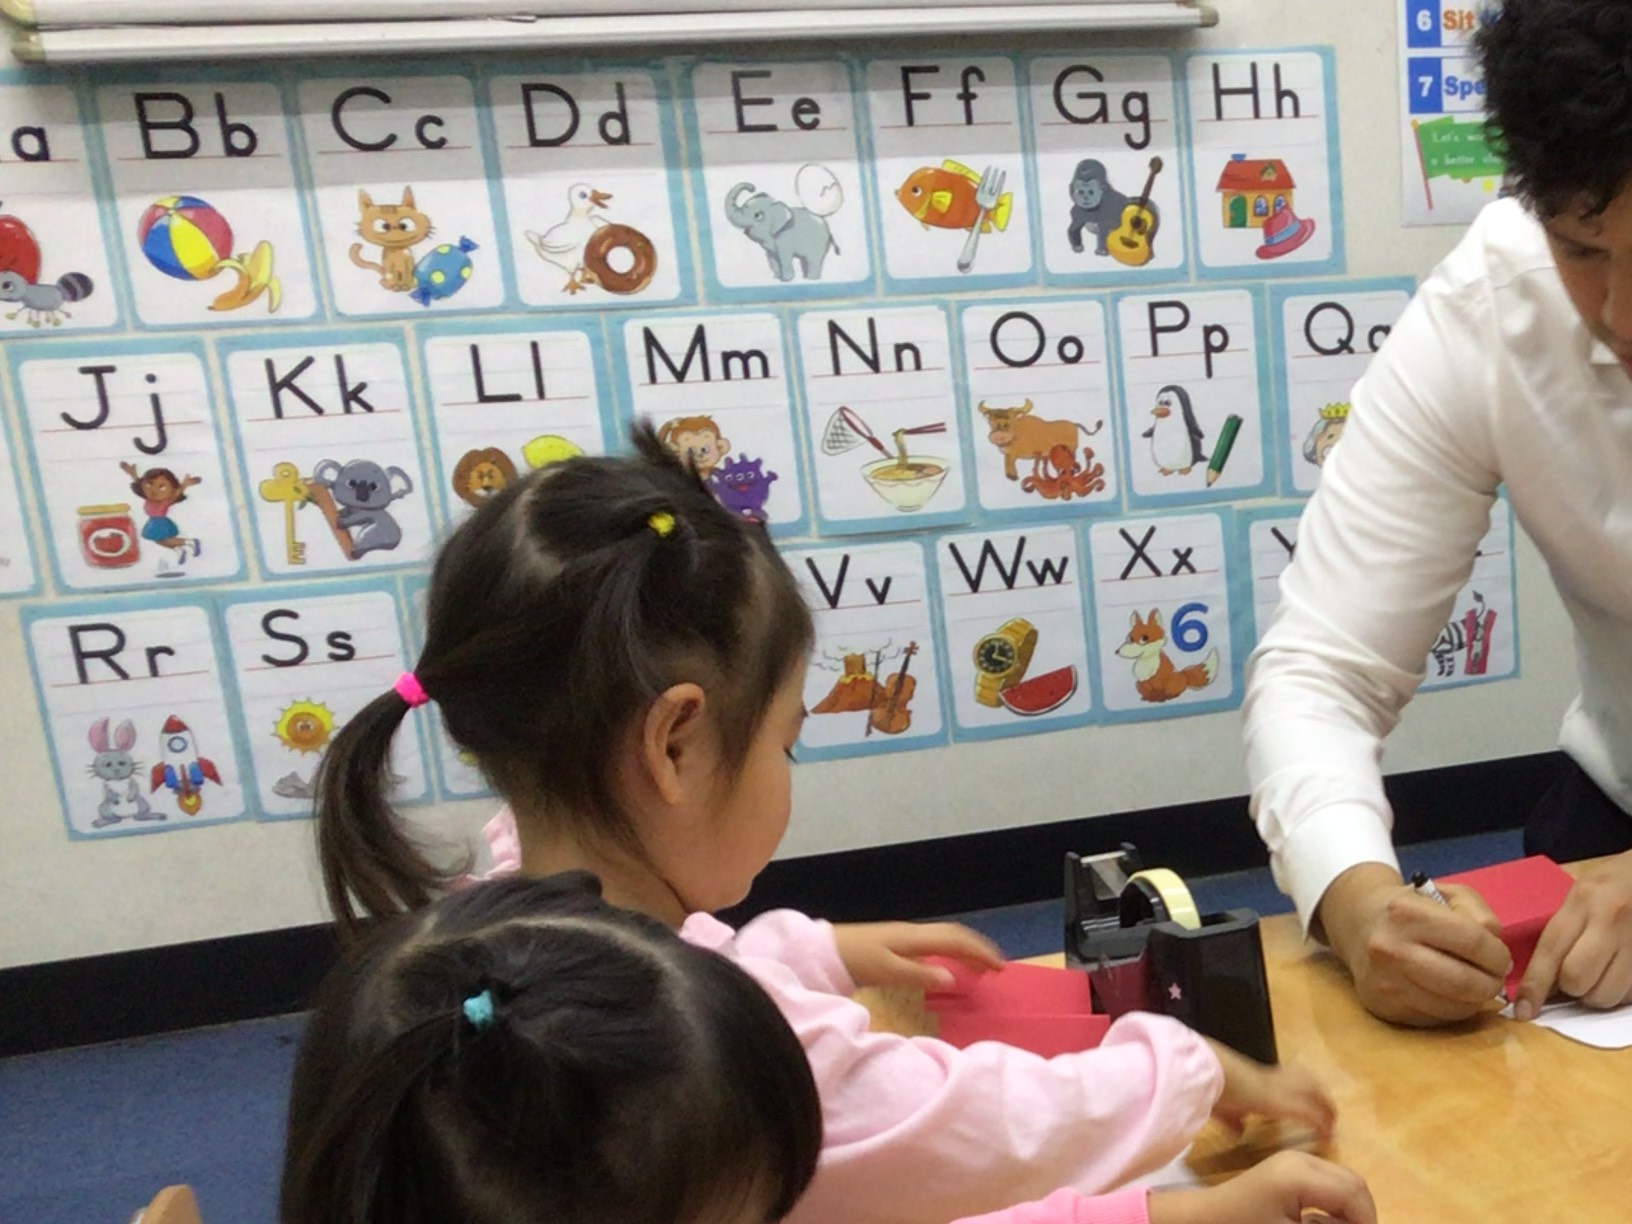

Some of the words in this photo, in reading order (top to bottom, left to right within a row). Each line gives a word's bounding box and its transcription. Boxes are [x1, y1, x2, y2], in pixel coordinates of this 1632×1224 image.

[1416, 9, 1432, 31] 6
[1443, 10, 1474, 31] Sit
[331, 85, 447, 152] Cc
[519, 81, 631, 148] Dd
[730, 69, 820, 133] Ee
[899, 63, 986, 127] Ff
[1052, 63, 1151, 150] Gg
[1212, 62, 1300, 121] Hh
[1418, 76, 1433, 97] 7
[1444, 76, 1485, 100] Spe
[133, 92, 258, 160] Bb
[643, 324, 770, 385] Mm
[828, 317, 922, 376] Nn
[990, 311, 1084, 368] Oo
[1148, 300, 1229, 379] Pp
[265, 354, 374, 420] Kk
[470, 341, 545, 404] Ll
[61, 365, 167, 456] Jj
[806, 554, 892, 608] Vv
[948, 536, 1069, 594] Ww
[1119, 526, 1197, 581] Xx
[68, 623, 175, 685] Rr
[262, 609, 356, 668] Ss
[1171, 602, 1210, 652] 6
